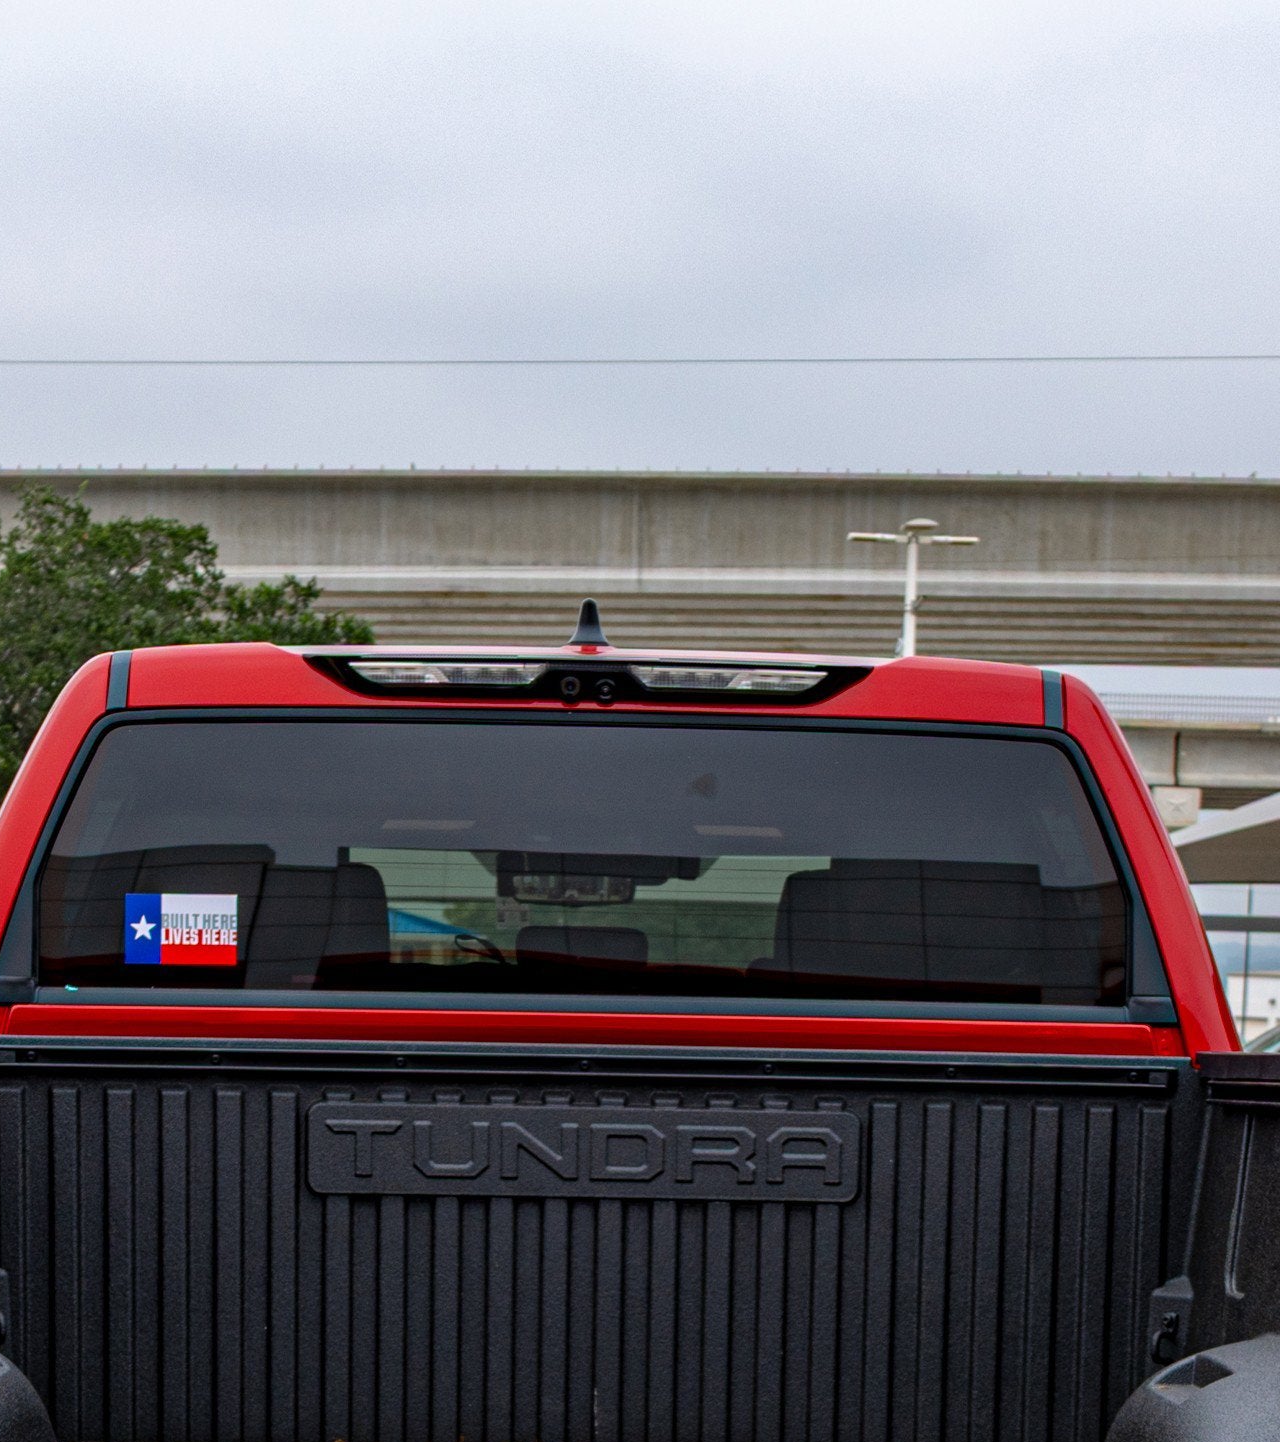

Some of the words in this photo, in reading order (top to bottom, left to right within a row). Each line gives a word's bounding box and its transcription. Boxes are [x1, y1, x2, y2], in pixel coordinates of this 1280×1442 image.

[161, 913, 199, 929] BUILT
[202, 914, 237, 930] HERE
[161, 928, 199, 945] LIVES
[201, 929, 237, 946] HERE
[324, 1118, 843, 1187] TUNDRA
